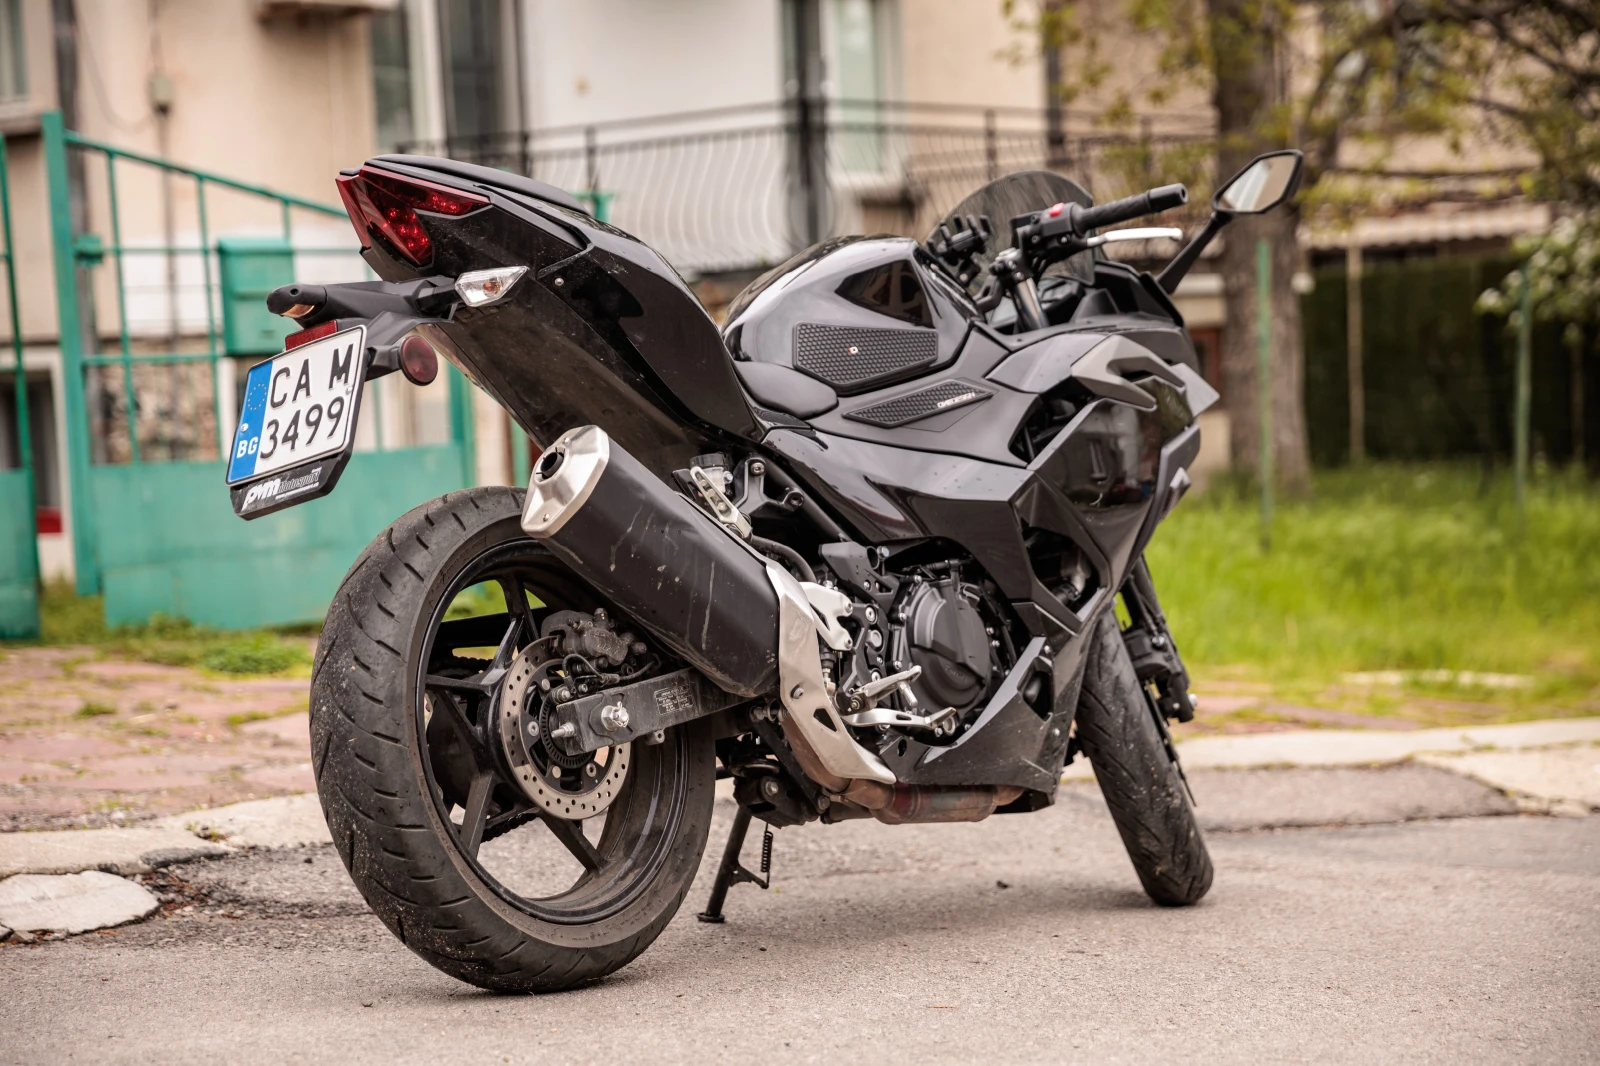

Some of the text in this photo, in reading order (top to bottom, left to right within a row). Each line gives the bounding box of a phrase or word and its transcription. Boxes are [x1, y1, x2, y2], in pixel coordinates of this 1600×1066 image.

[270, 343, 355, 409] CA M
[236, 436, 259, 459] BG
[259, 395, 345, 460] 3499
